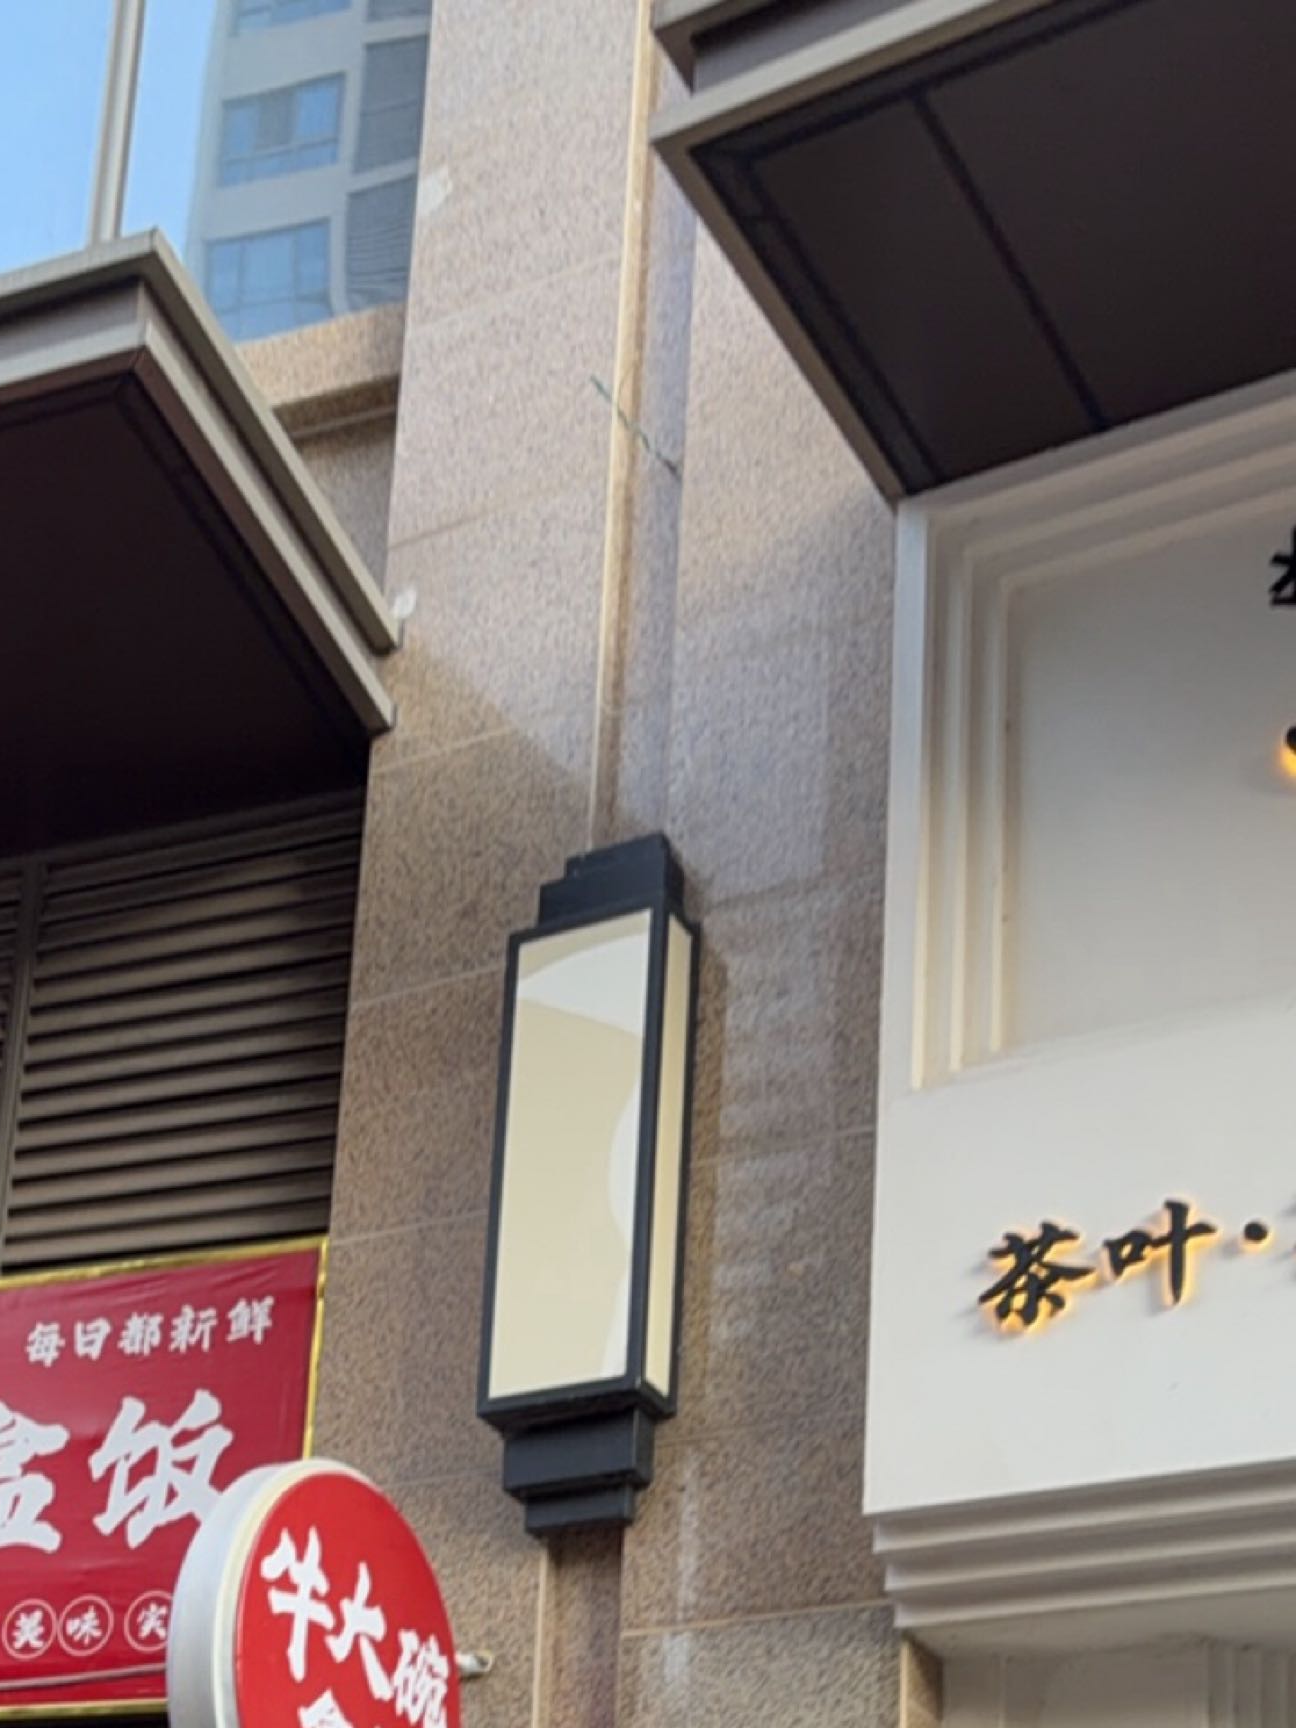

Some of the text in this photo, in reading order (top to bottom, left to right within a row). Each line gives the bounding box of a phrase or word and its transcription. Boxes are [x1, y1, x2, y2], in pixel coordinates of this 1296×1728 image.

[25, 1296, 275, 1368] 每日都新鲜
